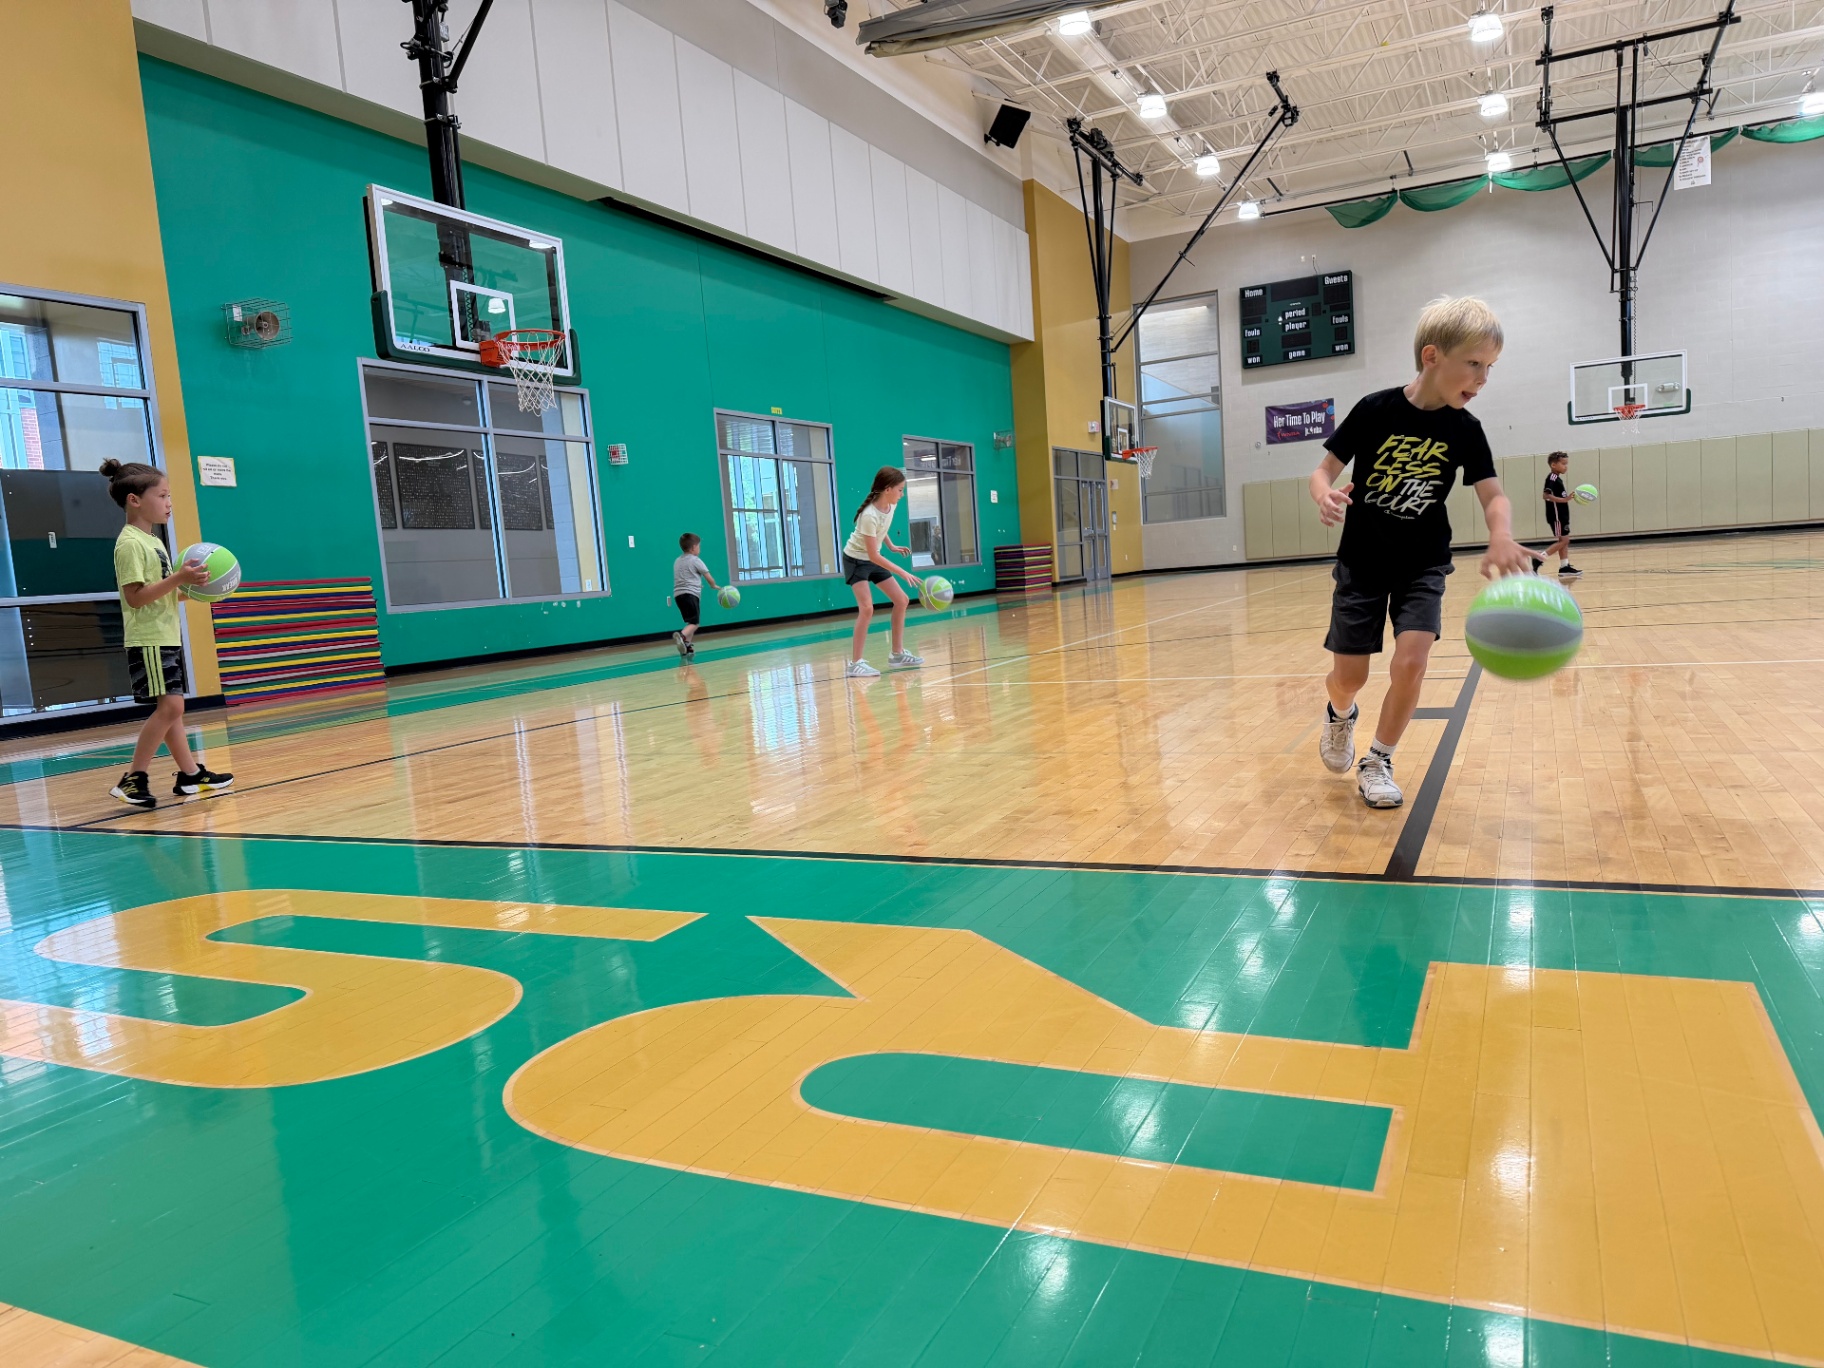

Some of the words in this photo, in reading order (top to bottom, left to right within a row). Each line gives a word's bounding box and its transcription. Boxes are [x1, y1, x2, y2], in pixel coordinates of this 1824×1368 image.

[1324, 274, 1348, 285] Guests
[1244, 288, 1264, 298] Home
[1284, 308, 1306, 320] period
[1332, 315, 1349, 324] fouls
[1284, 321, 1307, 332] player
[1244, 328, 1260, 337] fouls
[1334, 343, 1349, 352] won
[1247, 355, 1261, 364] won
[1288, 349, 1306, 360] game
[1273, 415, 1285, 428] Her
[1285, 414, 1302, 426] Time
[1302, 412, 1311, 425] To
[1311, 411, 1326, 424] Play
[1376, 433, 1450, 462] FEAR
[1373, 451, 1442, 478] LESS
[1365, 472, 1403, 493] ON
[1400, 478, 1444, 498] THE
[1364, 490, 1438, 515] COURT
